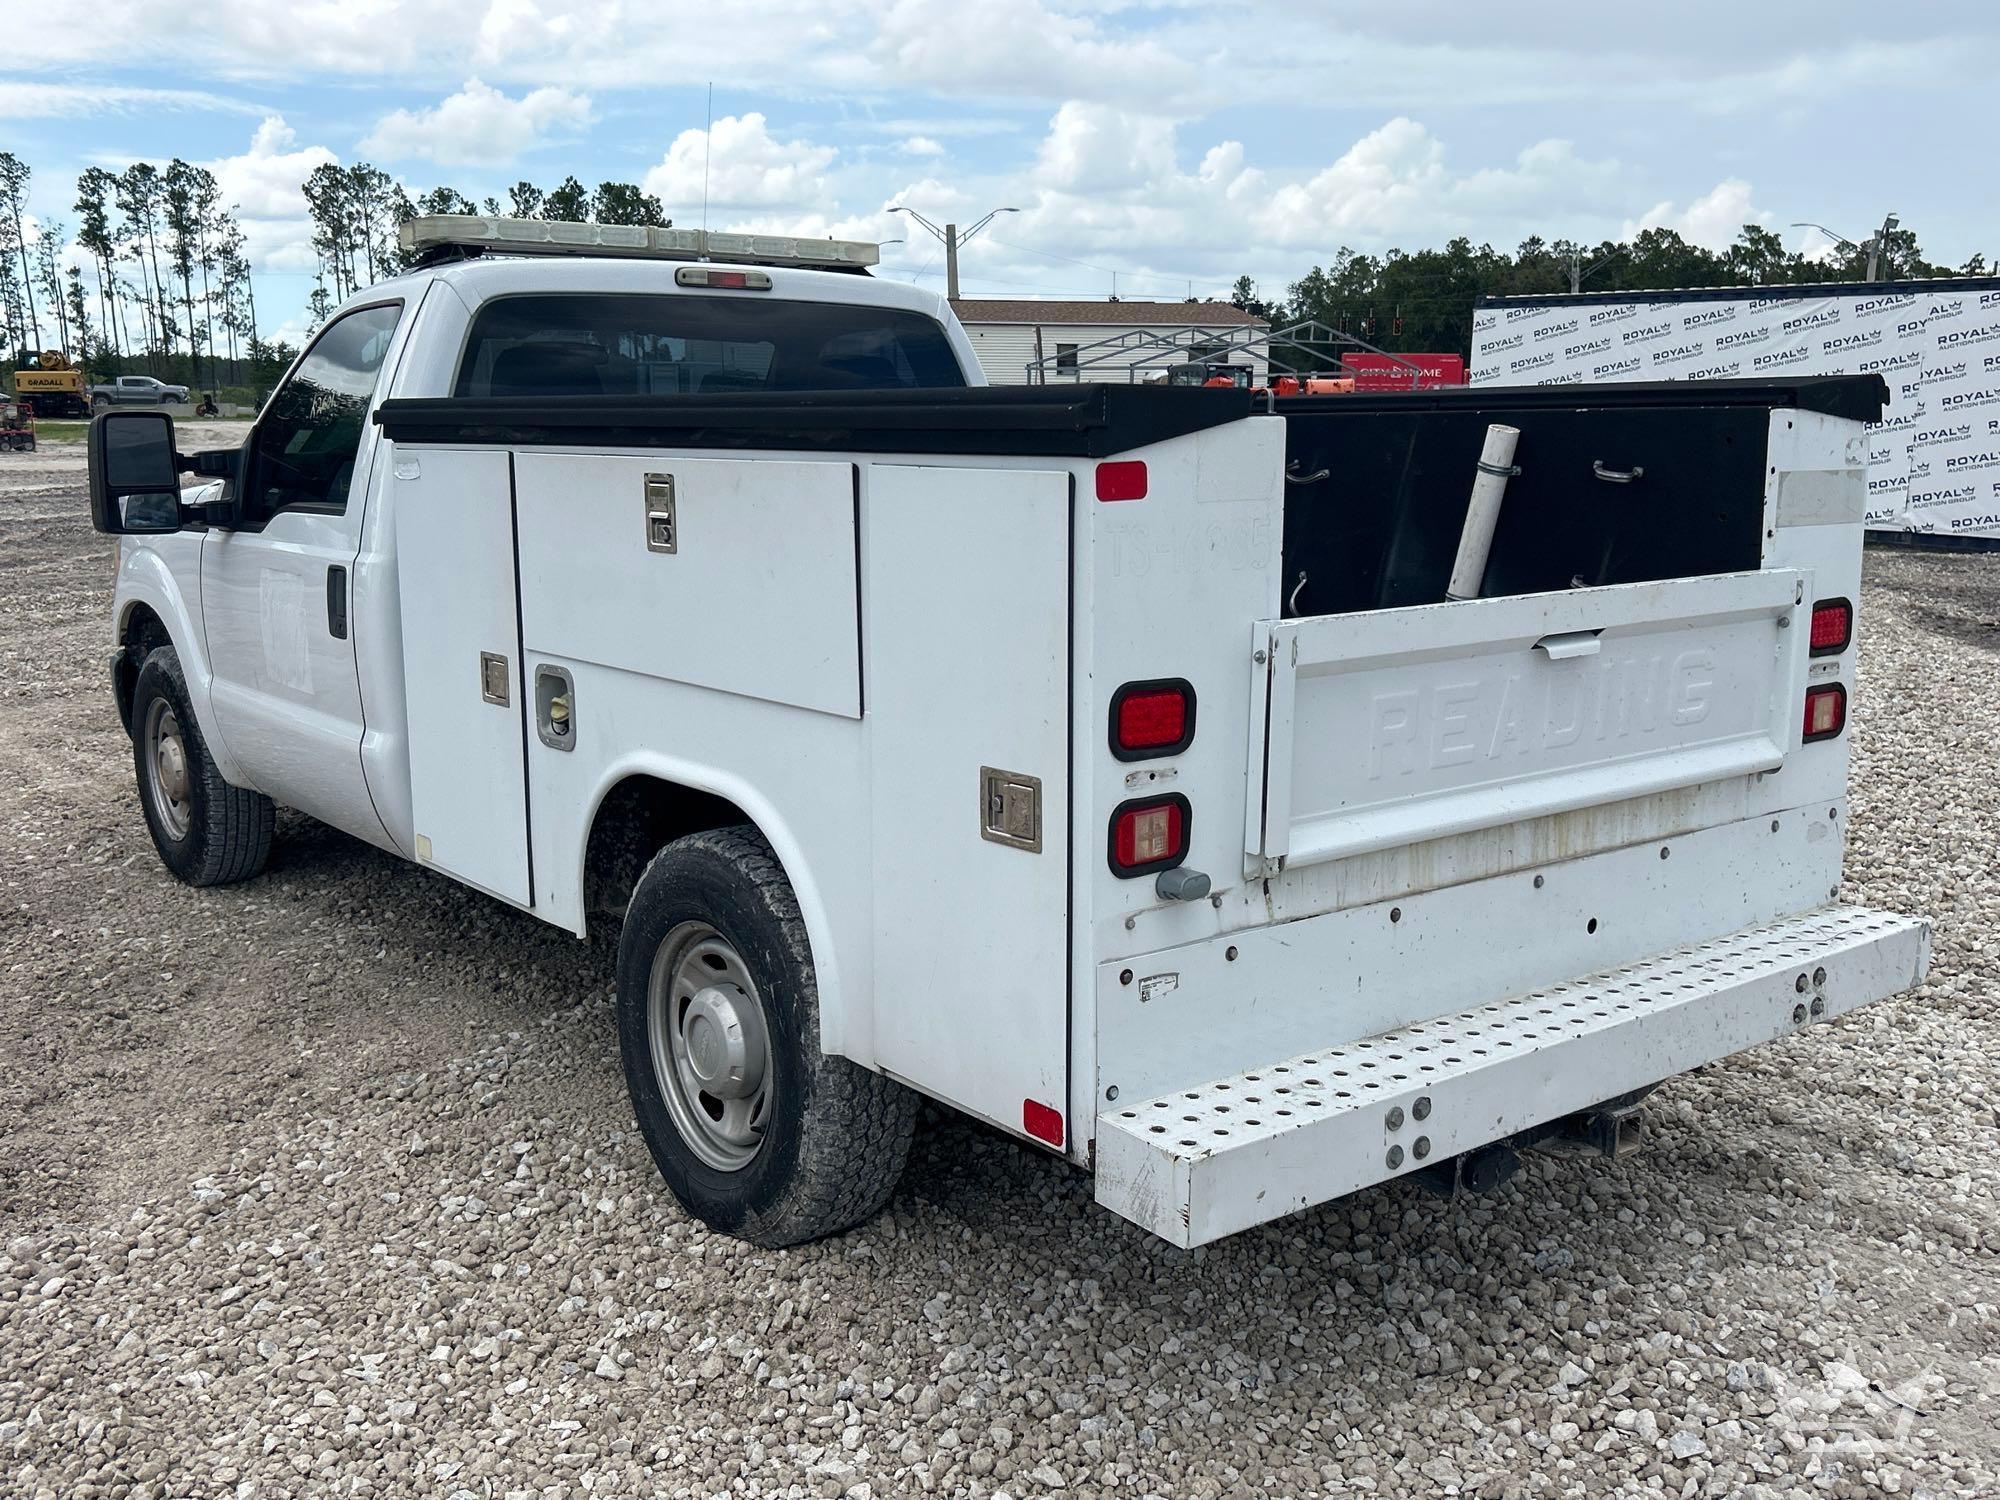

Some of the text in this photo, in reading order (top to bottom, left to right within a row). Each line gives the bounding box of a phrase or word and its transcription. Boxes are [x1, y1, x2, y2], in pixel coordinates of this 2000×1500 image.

[1751, 305, 1779, 314] AUCTION
[1855, 295, 1902, 312] ROYAL
[1590, 308, 1626, 322] ROYAL
[1684, 311, 1723, 325] ROYAL
[1856, 307, 1889, 318] AUCTION
[1685, 321, 1712, 330] AUCTION
[1783, 314, 1827, 329] ROYAL
[1534, 323, 1568, 337] ROYAL
[1623, 327, 1660, 341] ROYAL
[1784, 324, 1814, 335] AUCTION
[1937, 328, 1989, 344] ROYAL
[1481, 338, 1514, 351] ROYAL
[1624, 337, 1649, 345] AUCTION
[1716, 331, 1757, 345] ROYAL
[1823, 334, 1868, 350] ROYAL
[1939, 339, 1974, 350] AUCTION
[1565, 341, 1601, 355] ROYAL
[1717, 341, 1745, 350] AUCTION
[1824, 344, 1856, 355] AUCTION
[1653, 346, 1691, 360] ROYAL
[1754, 351, 1796, 365] ROYAL
[1511, 356, 1544, 369] ROYAL
[1594, 360, 1630, 374] ROYAL
[1654, 357, 1681, 365] AUCTION
[1755, 361, 1784, 370] AUCTION
[1860, 356, 1906, 371] ROYAL
[1688, 366, 1728, 380] ROYAL
[1942, 390, 1995, 406] ROYAL
[1943, 402, 1979, 412] AUCTION
[1866, 428, 1897, 436] AUCTION
[1947, 452, 1997, 467] ROYAL
[1948, 464, 1982, 473] AUCTION
[1870, 487, 1901, 495] AUCTION
[1912, 489, 1961, 502] ROYAL
[1368, 650, 1716, 780] READING
